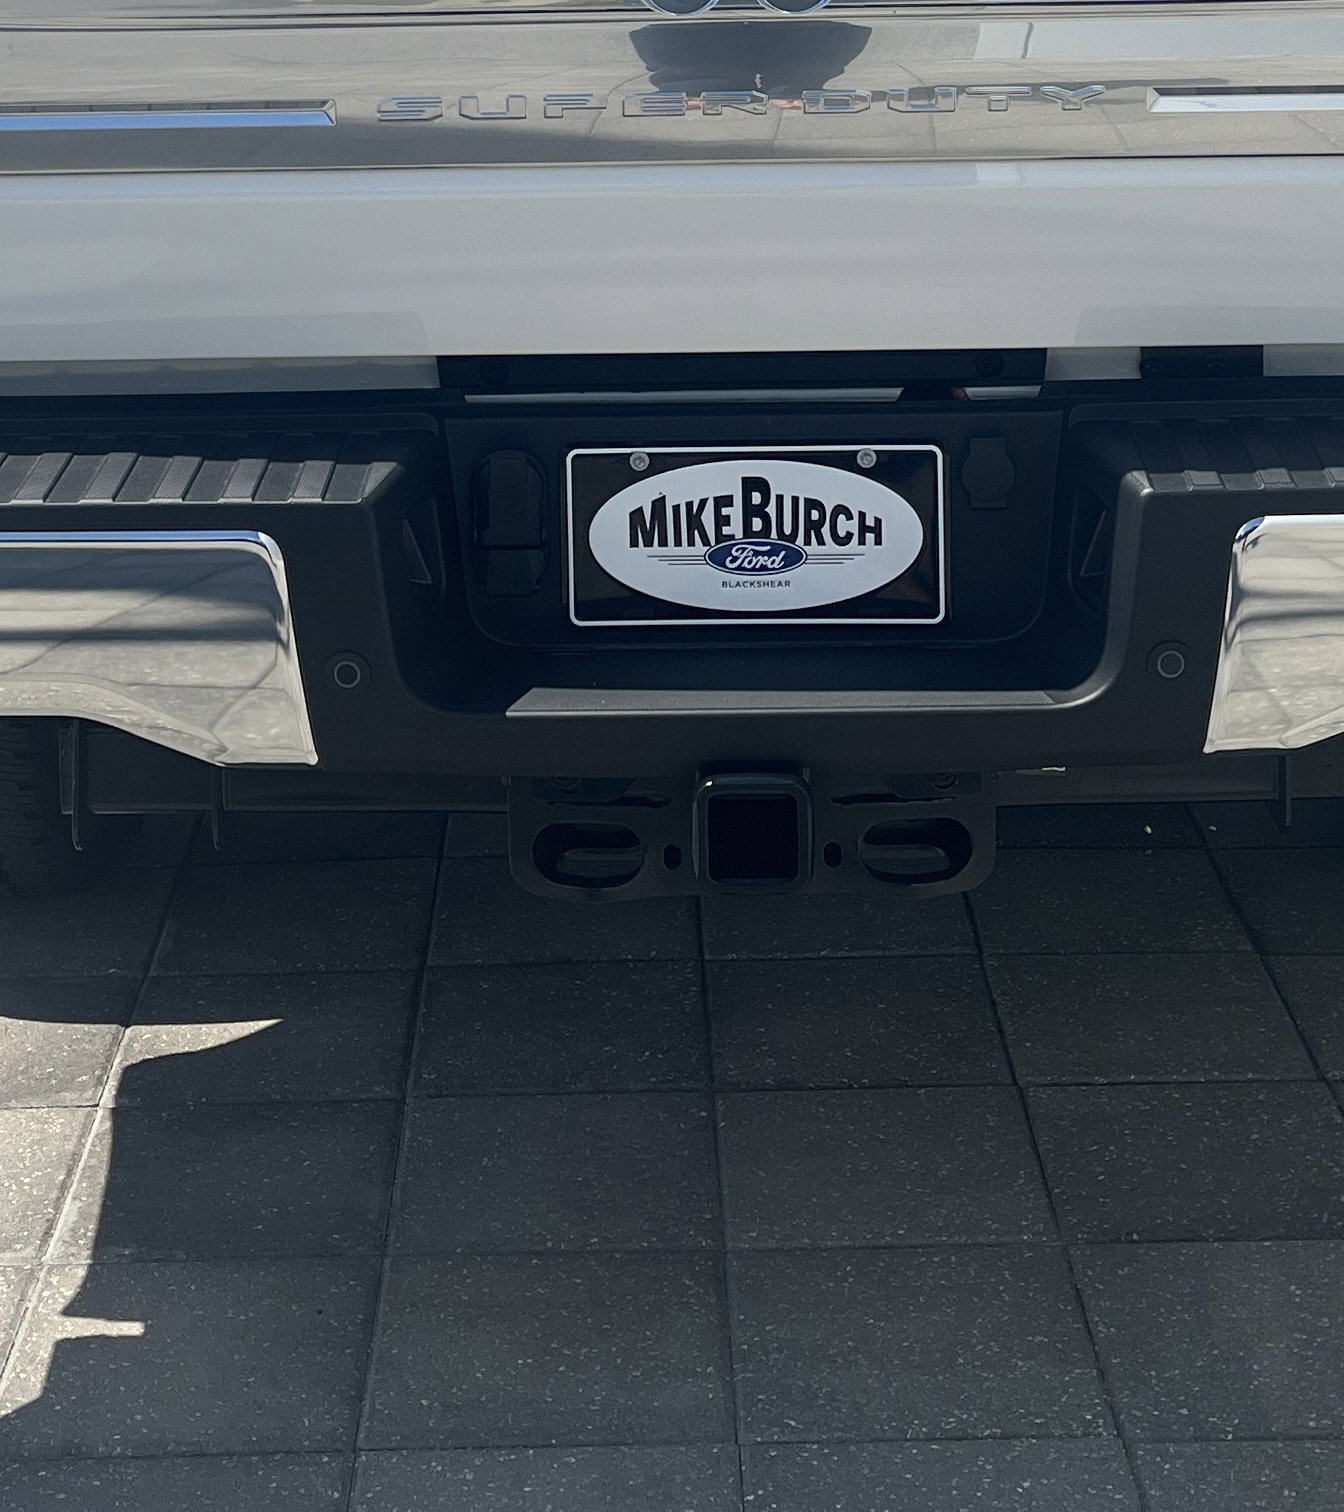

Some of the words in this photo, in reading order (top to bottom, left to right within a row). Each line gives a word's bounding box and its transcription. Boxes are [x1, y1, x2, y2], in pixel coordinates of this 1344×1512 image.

[376, 89, 770, 123] SUPER
[800, 83, 1106, 117] DUTY
[725, 544, 785, 570] Ford
[721, 580, 792, 589] BLACKSHEAR
